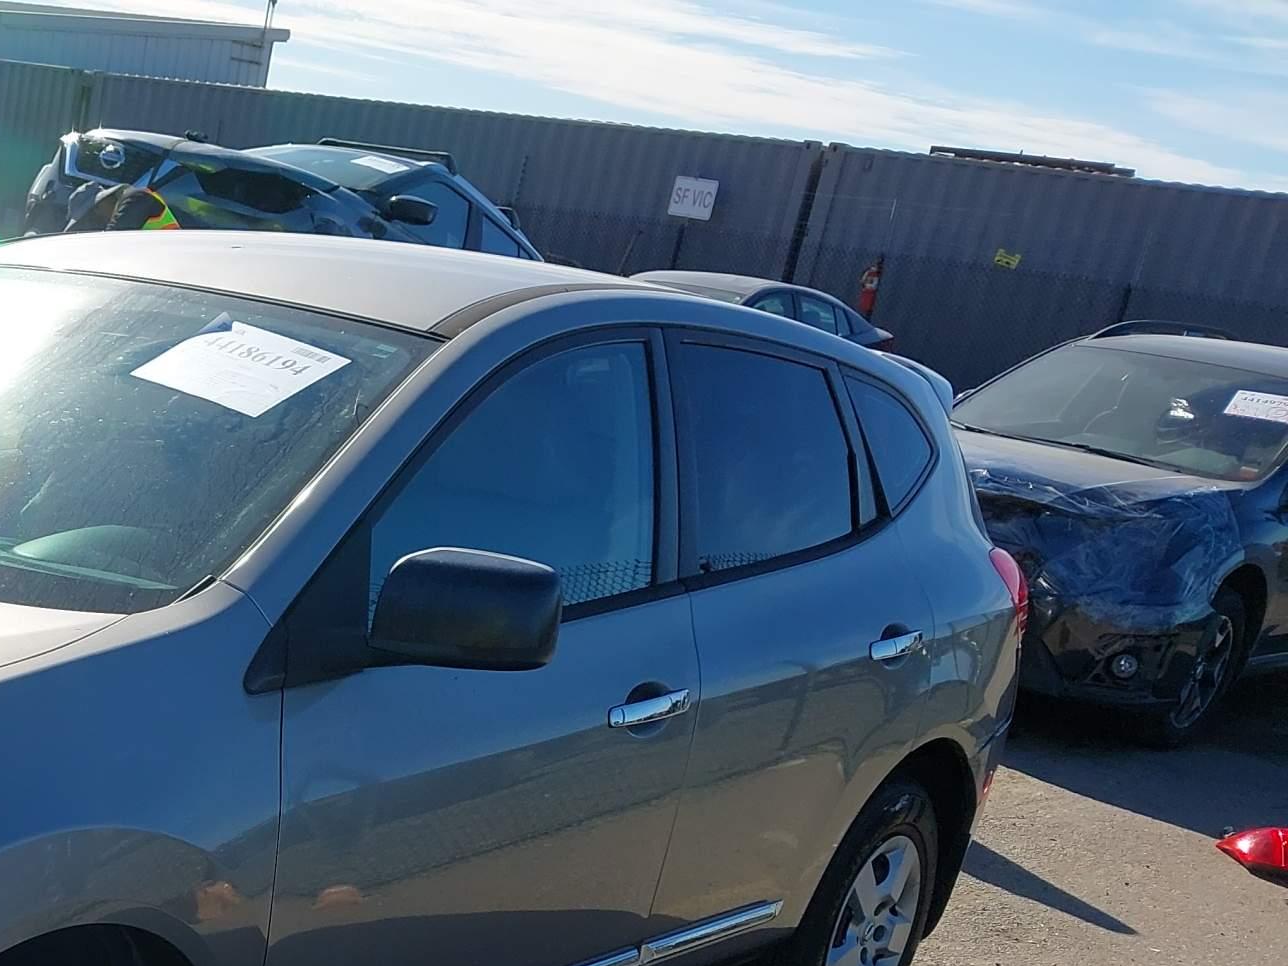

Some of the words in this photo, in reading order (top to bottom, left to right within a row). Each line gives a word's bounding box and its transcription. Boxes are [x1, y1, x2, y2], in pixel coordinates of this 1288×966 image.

[673, 187, 691, 205] SF
[692, 189, 713, 208] VIC
[203, 336, 313, 376] 44186194
